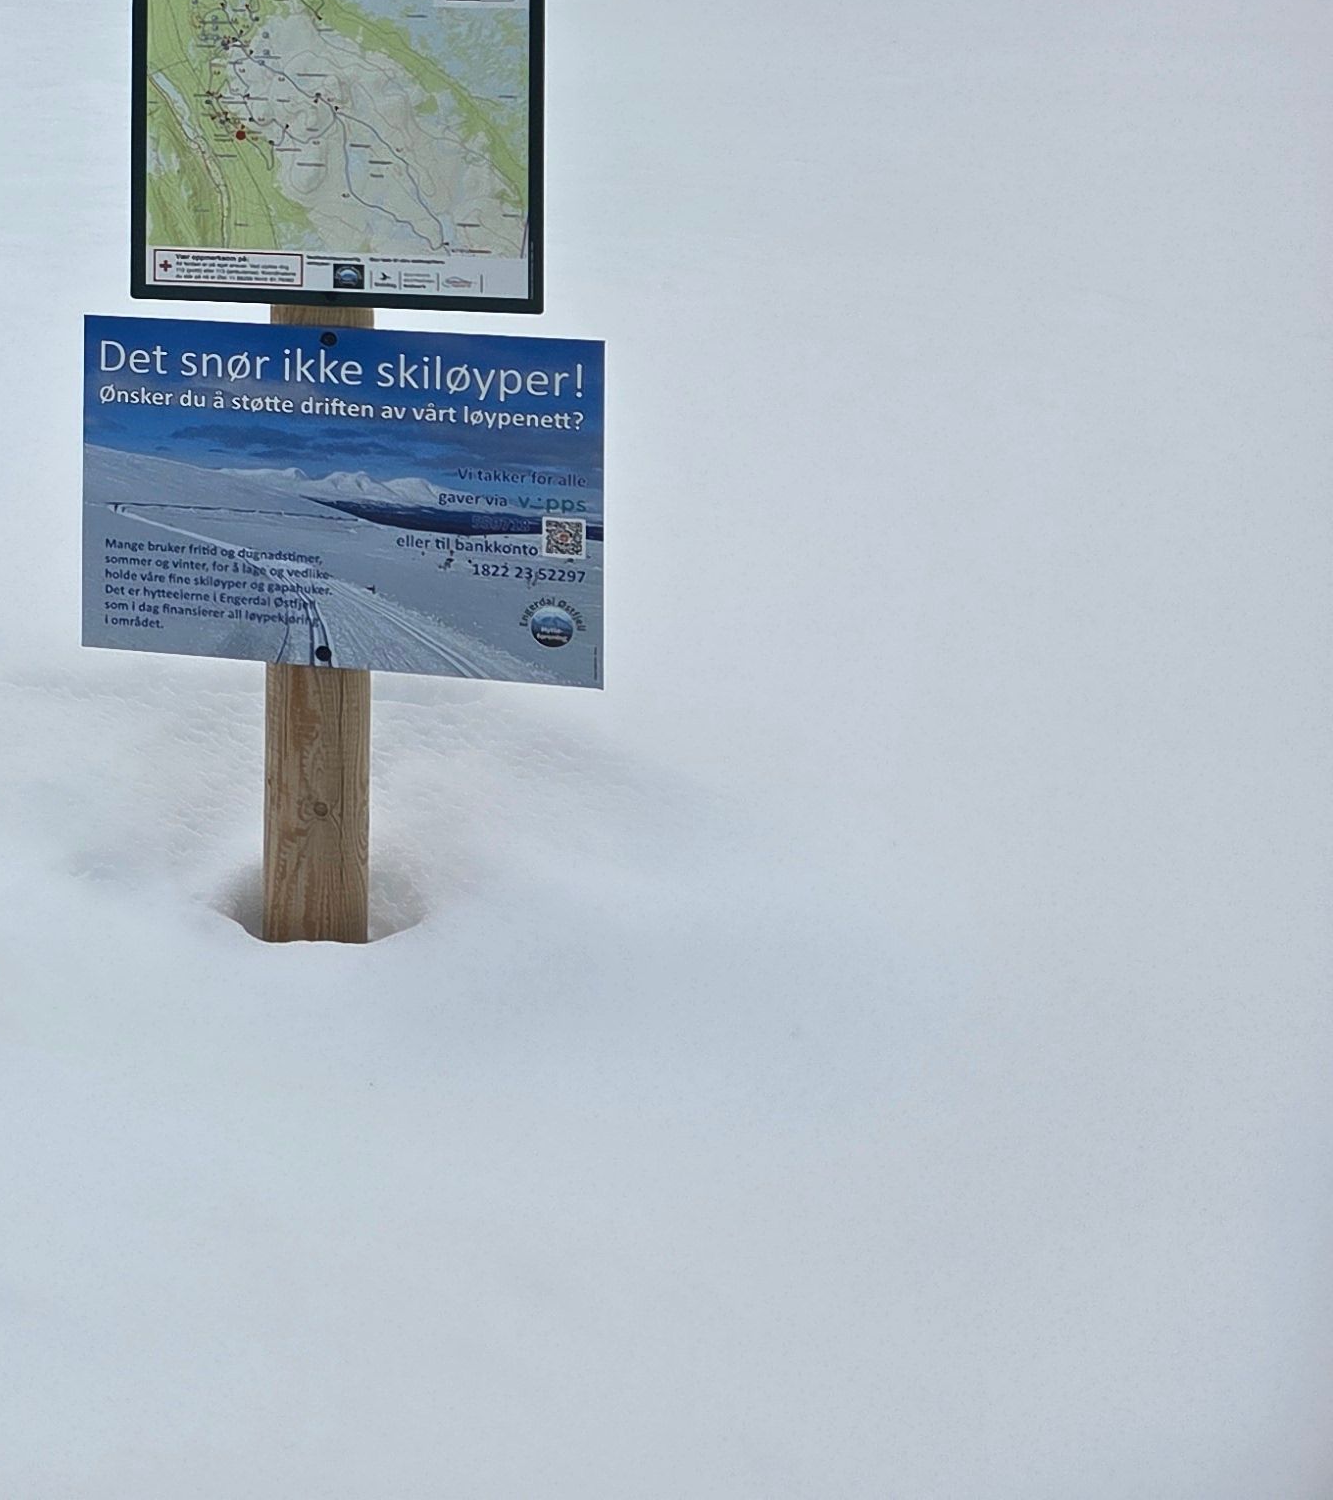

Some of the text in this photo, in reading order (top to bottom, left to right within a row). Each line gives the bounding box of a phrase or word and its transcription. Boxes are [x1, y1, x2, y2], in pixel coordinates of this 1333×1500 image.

[99, 340, 583, 402] Det snør ikke skiløyper!
[99, 384, 584, 431] Ønsker du å støtte driften av vårt løypenett?
[458, 468, 586, 488] Vi takker for alle
[438, 493, 480, 507] gaver
[484, 494, 508, 507] via
[105, 538, 323, 565] Mange bruker fritid og dugnadstimer,
[396, 534, 539, 556] eller til bankkonto
[105, 555, 152, 566] sommer
[155, 558, 170, 570] og
[172, 558, 209, 572] vinter,
[212, 560, 229, 572] for
[242, 563, 267, 577] lage
[269, 568, 284, 579] og
[472, 564, 586, 584] 1822 23 52297
[105, 568, 333, 596] holde våre fine skiløyper og gapahuker.
[105, 584, 125, 595] Det
[128, 588, 140, 596] er
[143, 586, 210, 601] hytteeierne
[220, 593, 271, 607] Engerdal
[105, 601, 129, 611] som
[138, 602, 159, 615] dag
[162, 603, 225, 618] finansierer
[228, 608, 242, 619] all
[111, 615, 164, 629] området.
